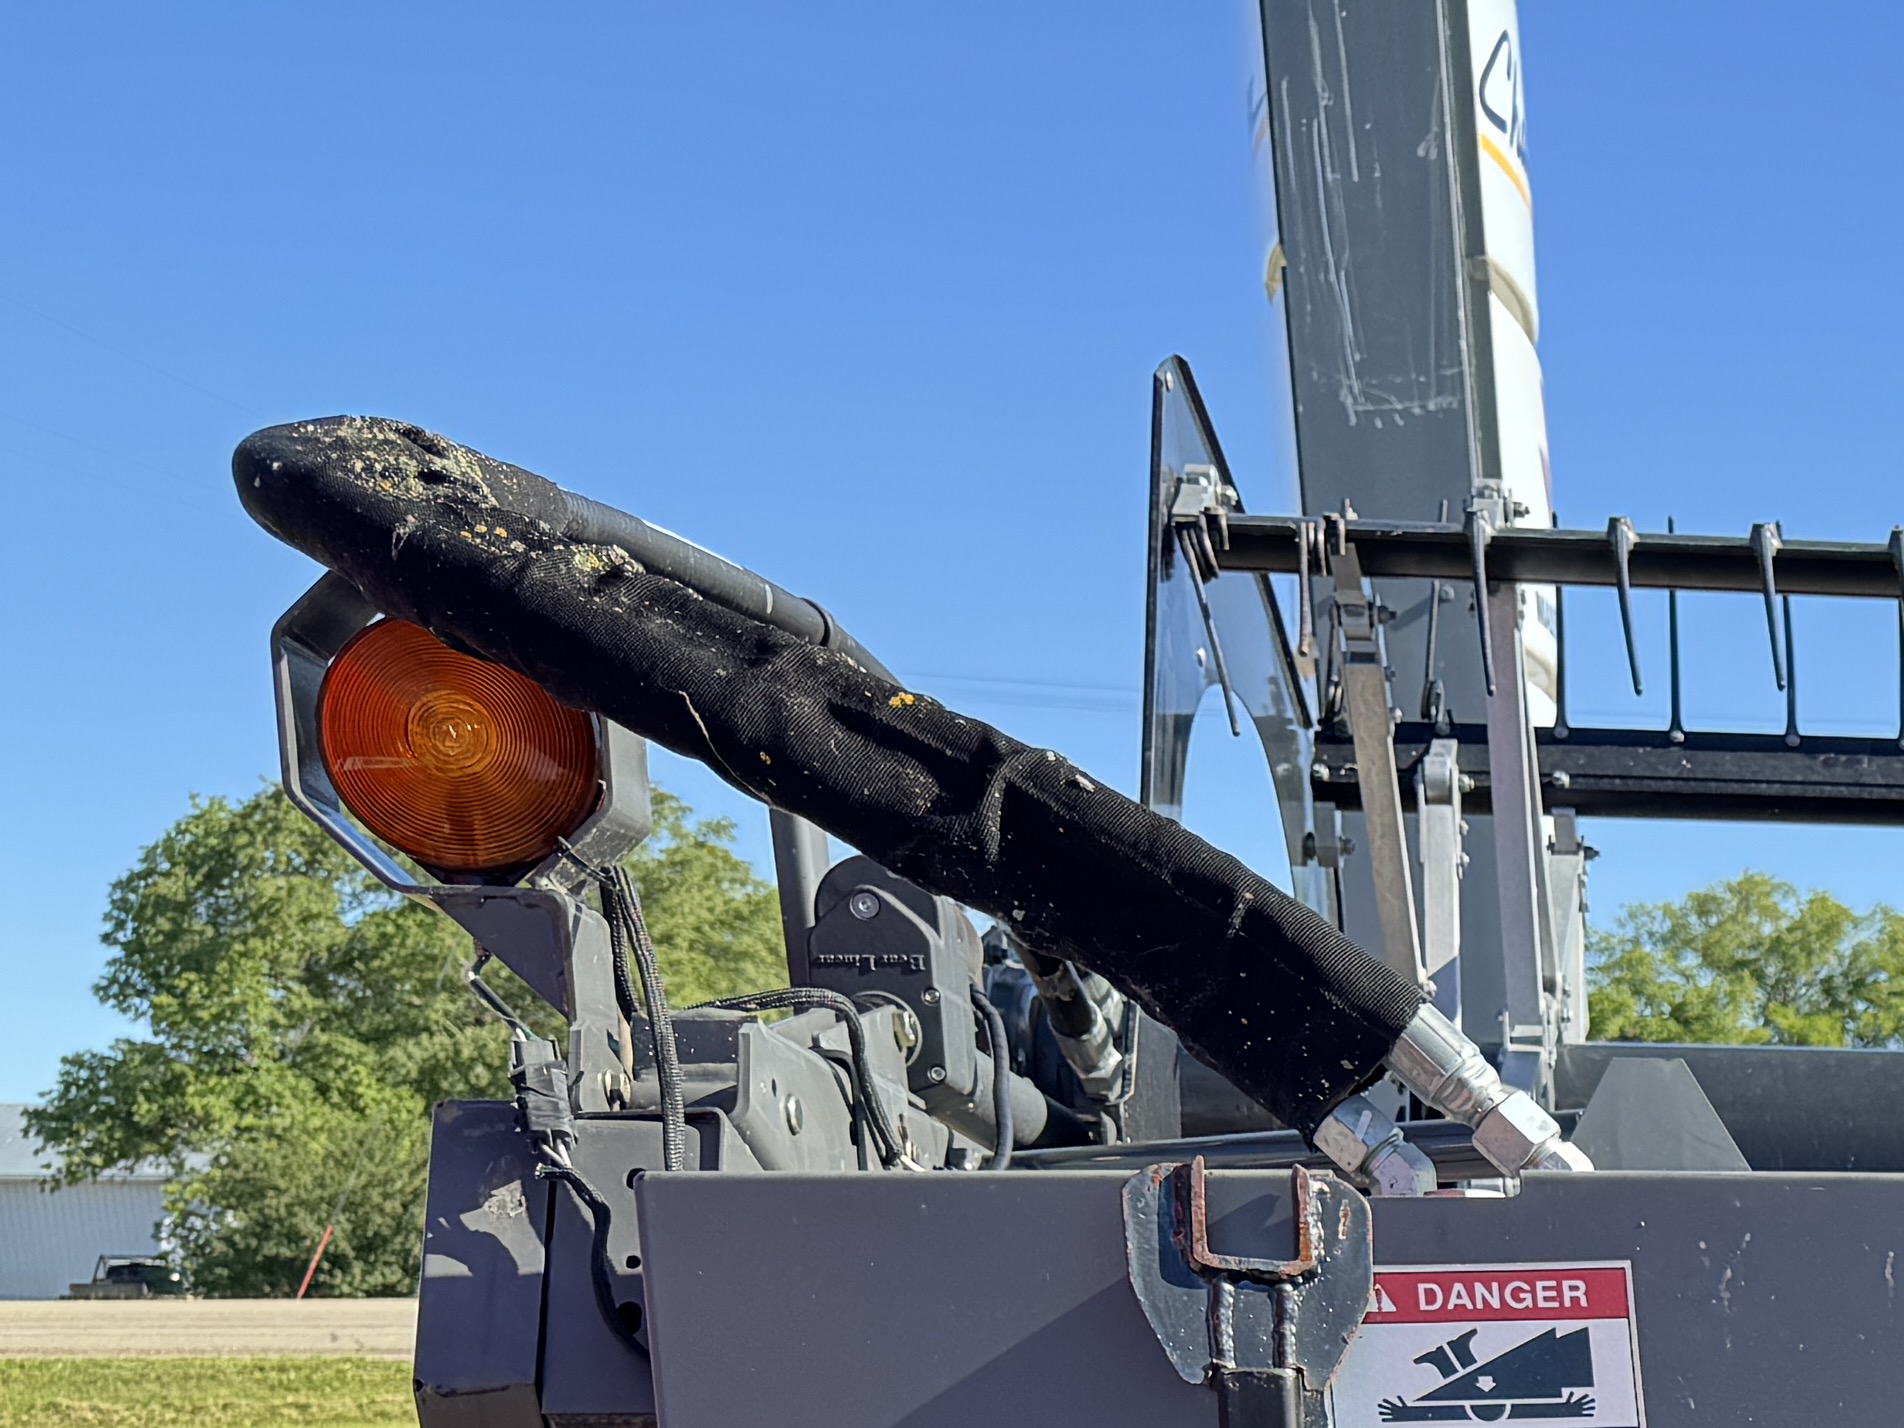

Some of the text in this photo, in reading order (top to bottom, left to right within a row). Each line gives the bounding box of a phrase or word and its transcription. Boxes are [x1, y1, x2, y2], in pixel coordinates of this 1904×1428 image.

[818, 954, 926, 971] Bear Linear
[1417, 1279, 1588, 1311] DANGER
